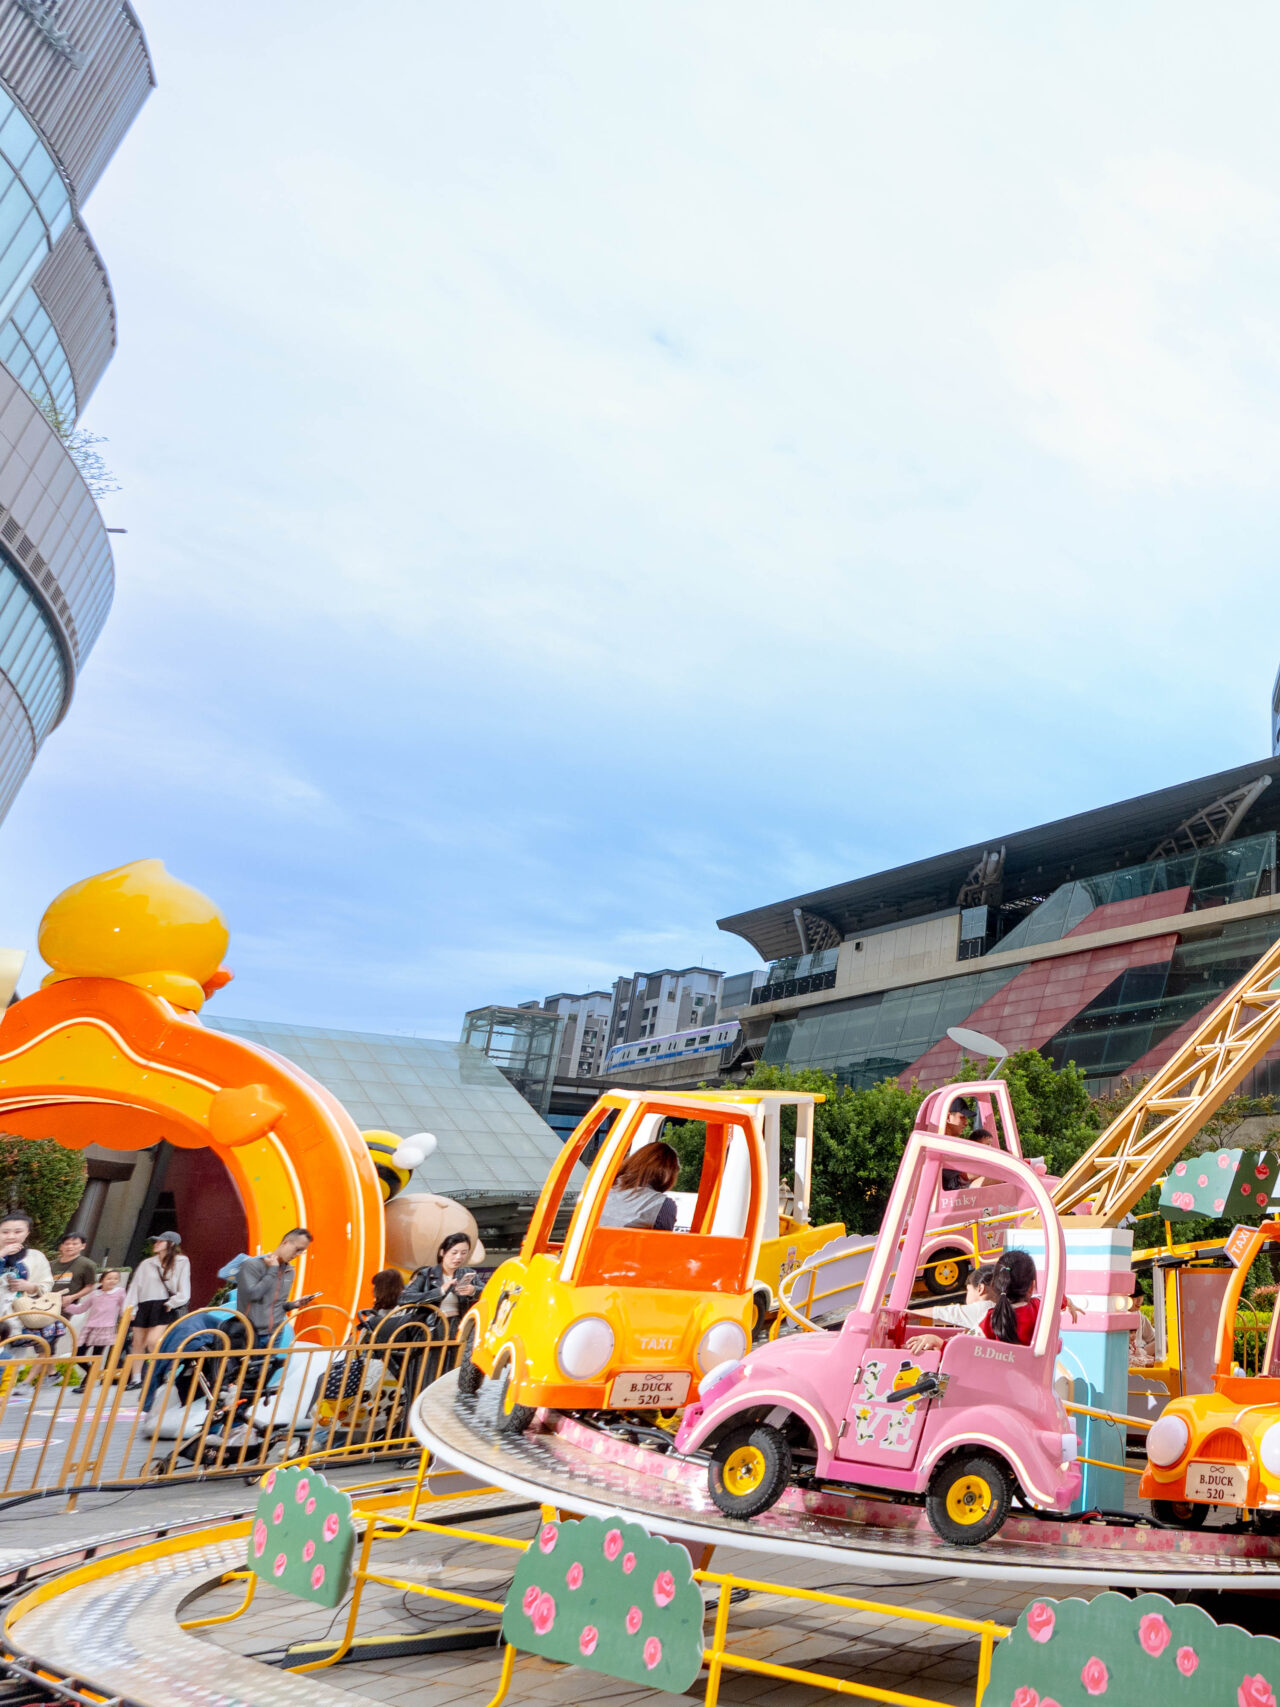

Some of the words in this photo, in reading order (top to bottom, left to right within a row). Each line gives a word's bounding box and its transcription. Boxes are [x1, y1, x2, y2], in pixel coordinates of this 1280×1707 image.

[941, 1194, 977, 1209] Pinky
[1230, 1229, 1251, 1254] TAXI
[640, 1338, 673, 1350] TAXI
[973, 1345, 1016, 1363] B.Duck
[629, 1382, 673, 1393] B.DUCK
[638, 1394, 660, 1405] 520
[1199, 1474, 1234, 1487] B.DUCK
[1206, 1488, 1225, 1500] 520
